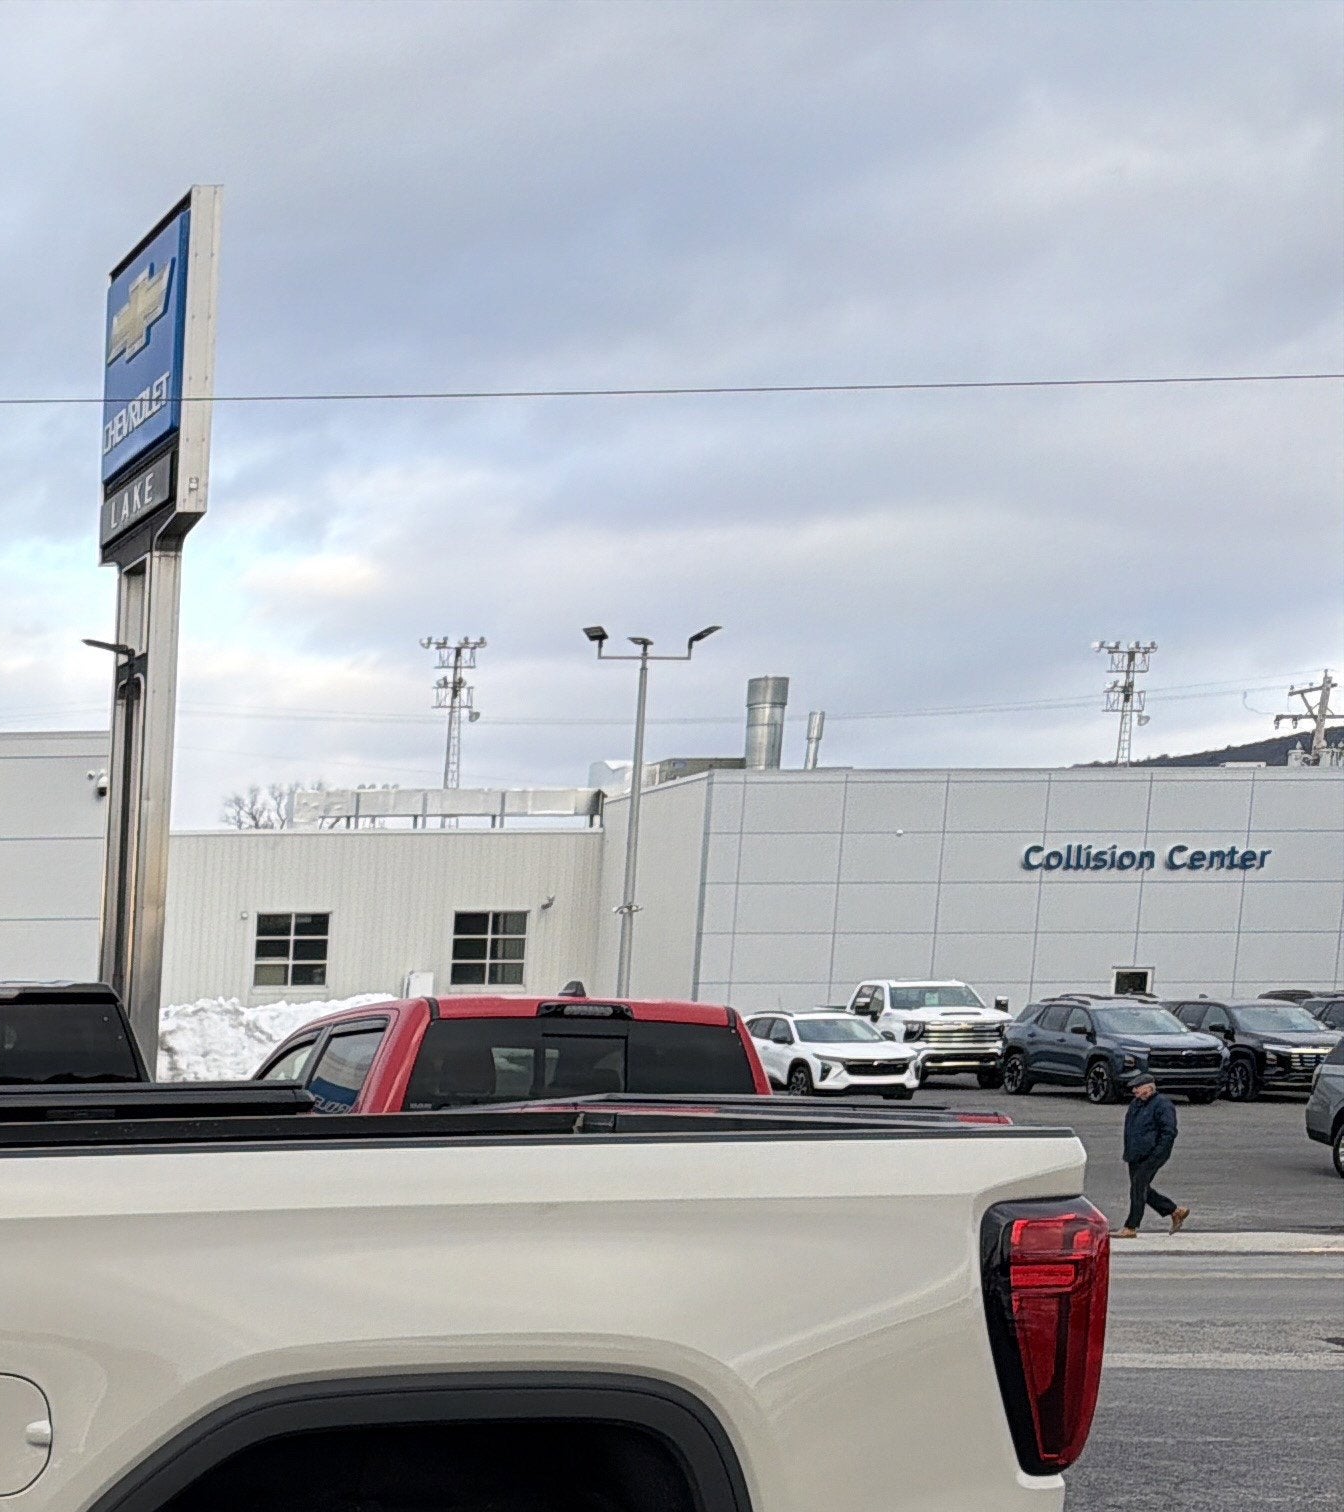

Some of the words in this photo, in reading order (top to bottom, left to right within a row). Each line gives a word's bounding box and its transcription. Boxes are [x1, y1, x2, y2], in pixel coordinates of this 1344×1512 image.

[103, 370, 170, 455] CHEVROLET
[110, 472, 154, 529] LAKE
[1022, 843, 1155, 871] Collision
[1165, 843, 1273, 871] Center
